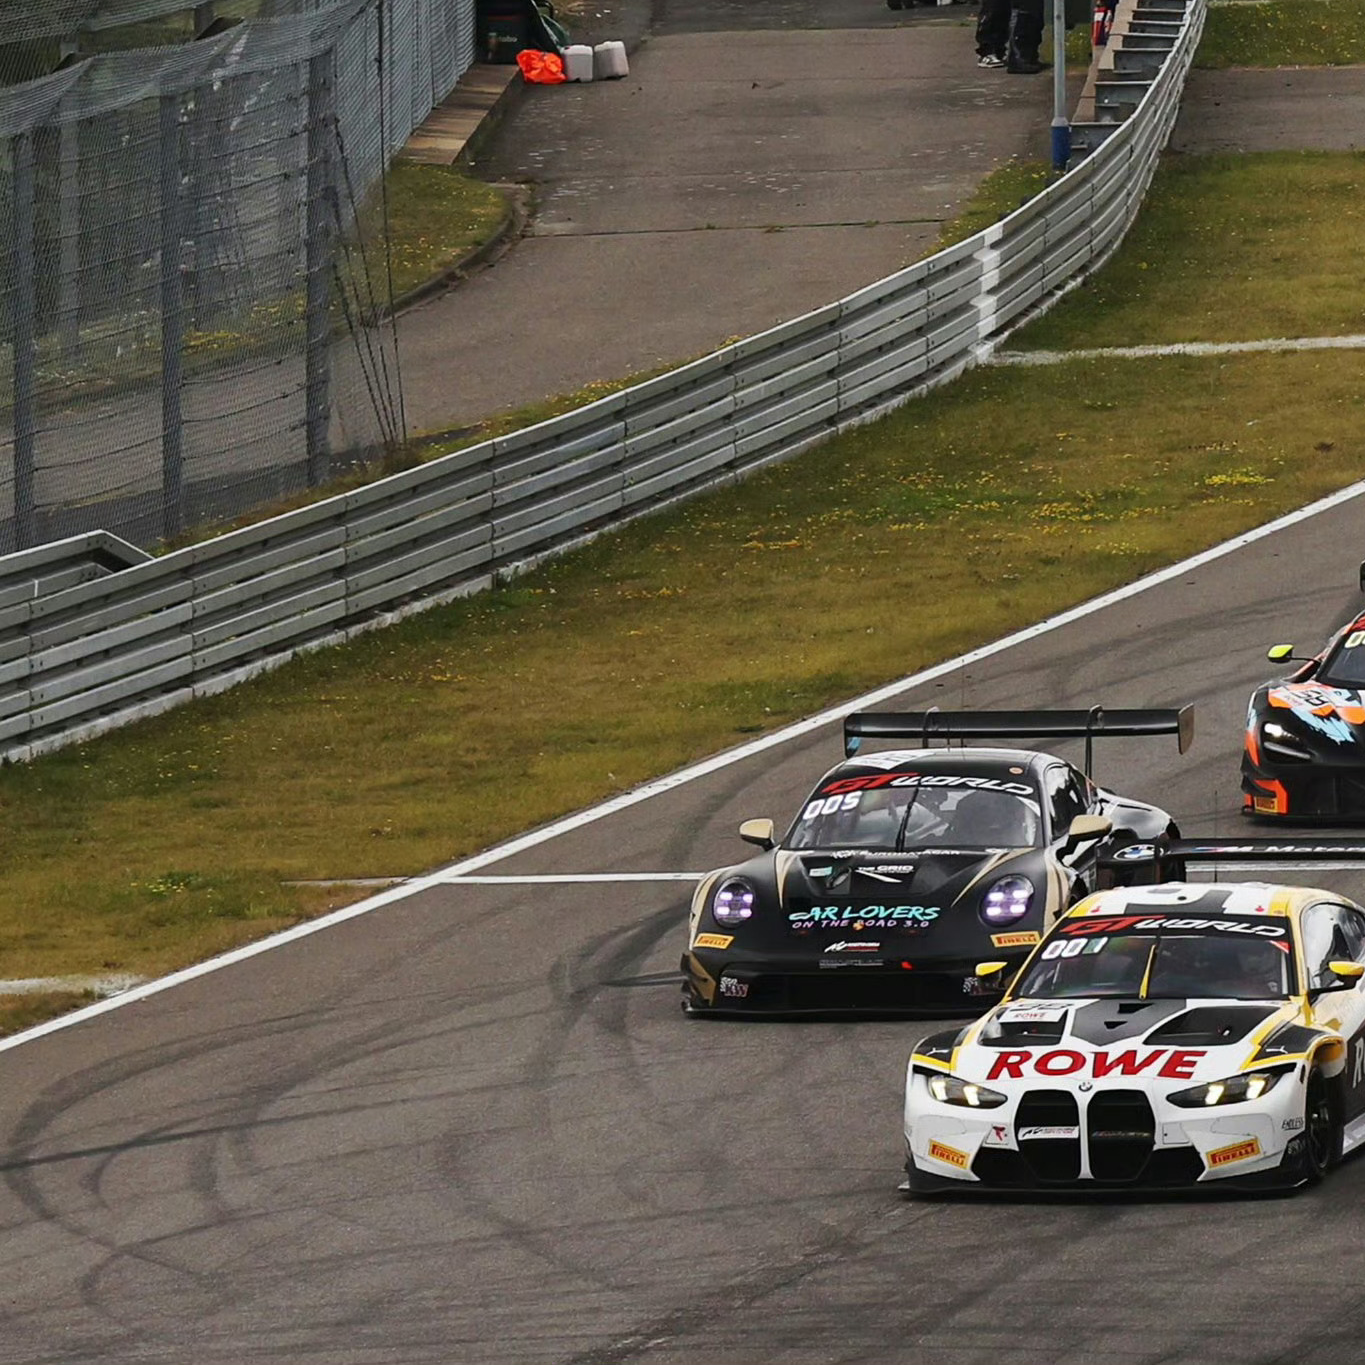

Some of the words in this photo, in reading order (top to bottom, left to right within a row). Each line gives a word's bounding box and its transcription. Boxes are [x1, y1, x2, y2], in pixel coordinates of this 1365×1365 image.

[890, 775, 1035, 795] WORLD
[843, 904, 941, 920] LOVERS
[792, 920, 816, 930] ON
[820, 919, 850, 929] THE
[903, 919, 930, 929] 3.0
[1140, 918, 1287, 938] WORLD
[696, 935, 732, 948] PIRELLI
[995, 933, 1038, 946] PIRELLI
[985, 1049, 1209, 1081] ROWE
[929, 1142, 967, 1167] PIRELLI
[1208, 1140, 1259, 1165] PIRELLI
